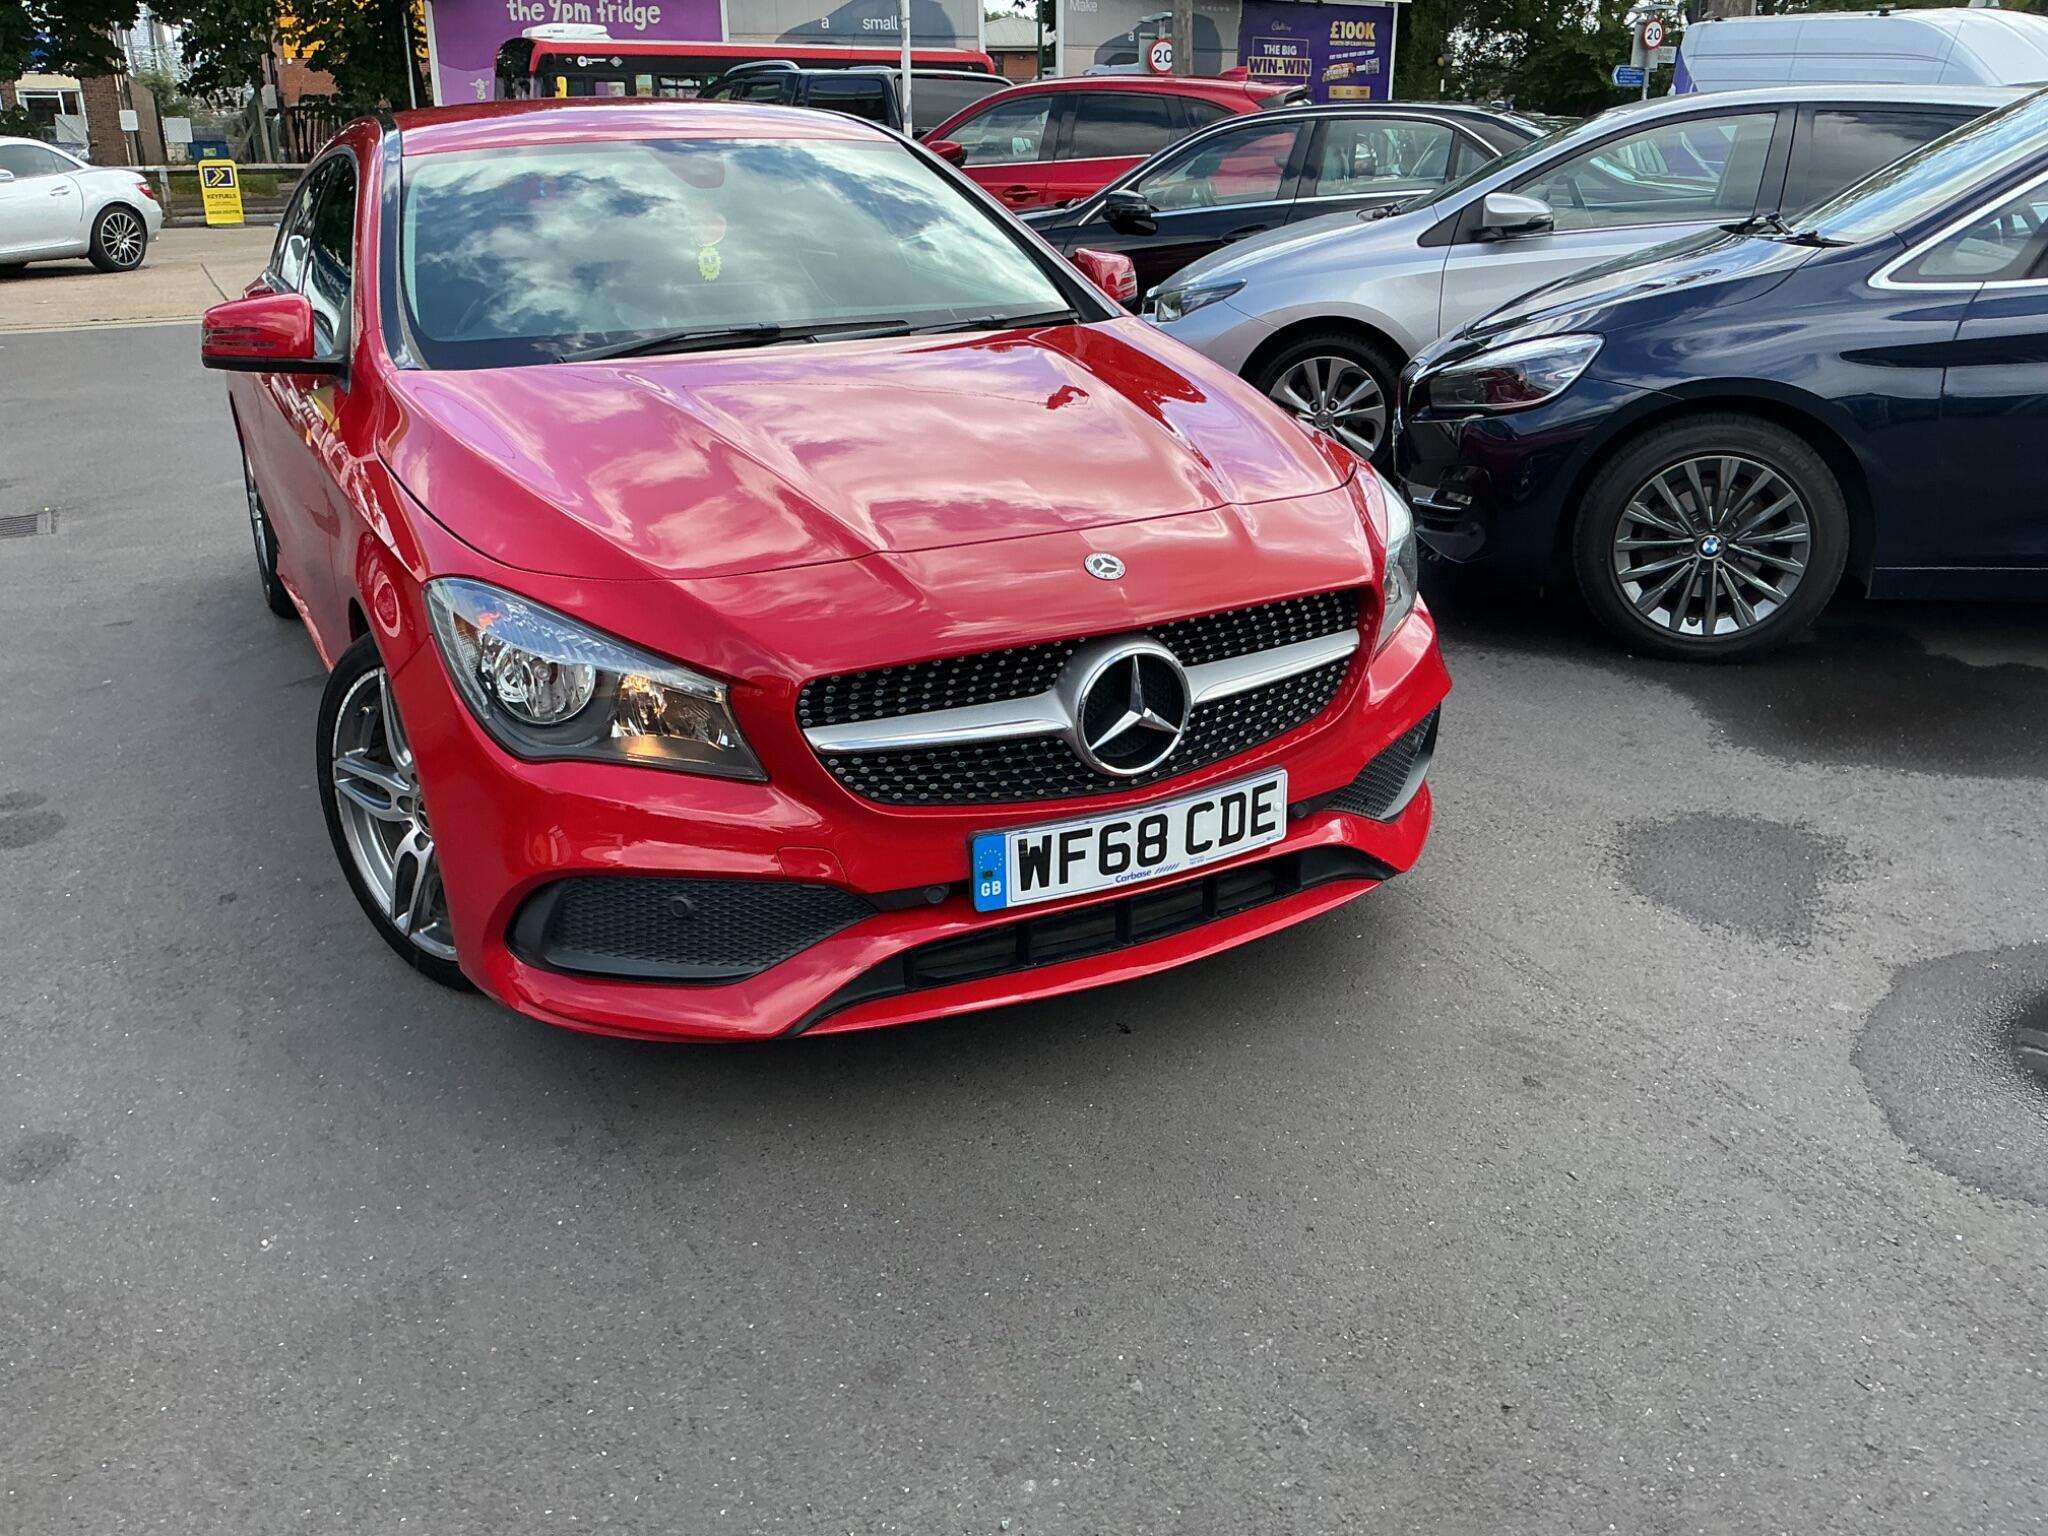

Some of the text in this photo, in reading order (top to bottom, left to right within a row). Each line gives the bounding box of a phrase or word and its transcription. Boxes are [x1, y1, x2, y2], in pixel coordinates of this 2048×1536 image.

[1069, 0, 1099, 13] Make
[507, 0, 661, 31] the 9pm fridge
[821, 15, 898, 31] a small
[1128, 32, 1135, 42] a
[1330, 21, 1376, 40] £100K
[1646, 28, 1661, 41] 20
[1153, 49, 1173, 64] 20
[1263, 44, 1298, 55] THE BIG
[1248, 59, 1310, 75] WIN-WIN
[1017, 780, 1278, 892] WF68 CDE
[1115, 869, 1152, 884] Carbase
[980, 879, 1002, 897] GB
